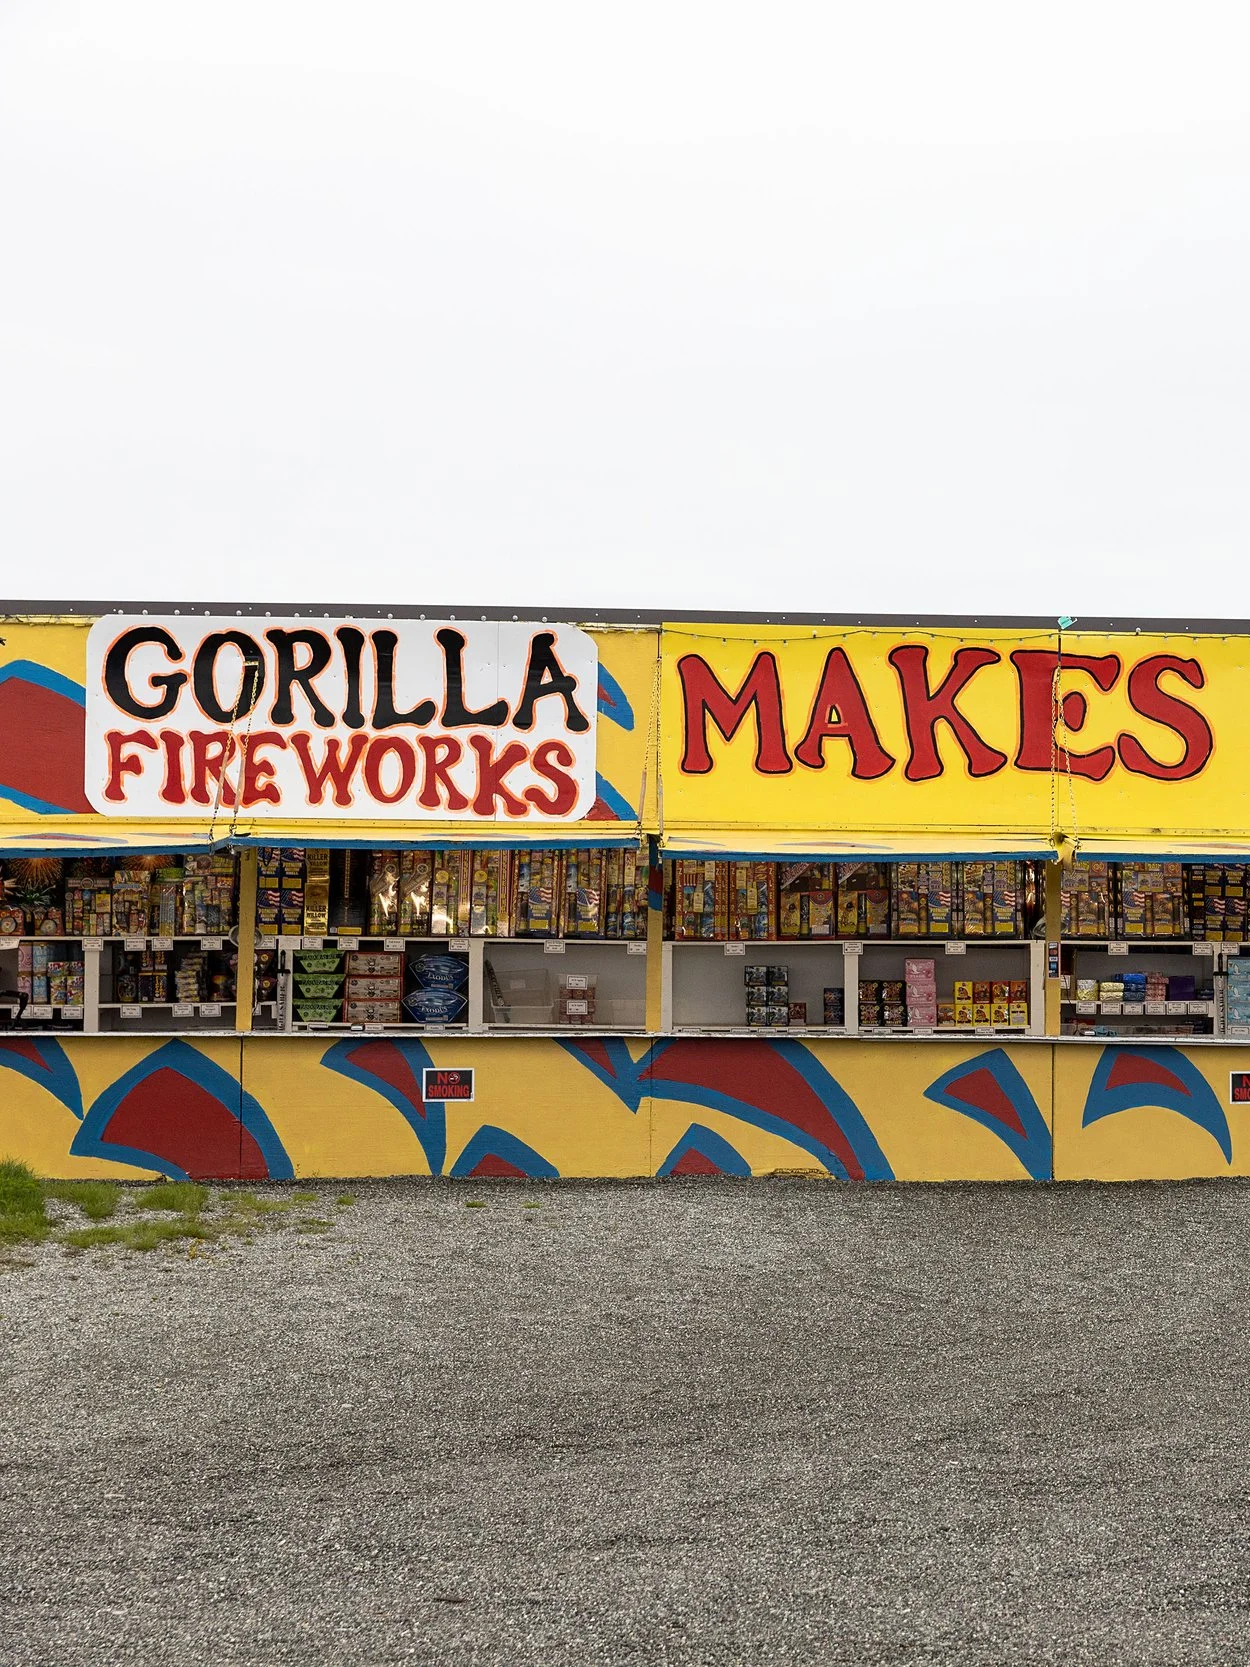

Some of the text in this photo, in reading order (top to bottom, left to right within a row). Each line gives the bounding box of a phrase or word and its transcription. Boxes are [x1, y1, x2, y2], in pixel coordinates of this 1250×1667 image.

[102, 625, 591, 734] GORILLA
[676, 645, 1215, 782] MAKES
[102, 728, 580, 817] FIREWORKS
[428, 1084, 469, 1097] SMOKING
[437, 1071, 460, 1084] NO
